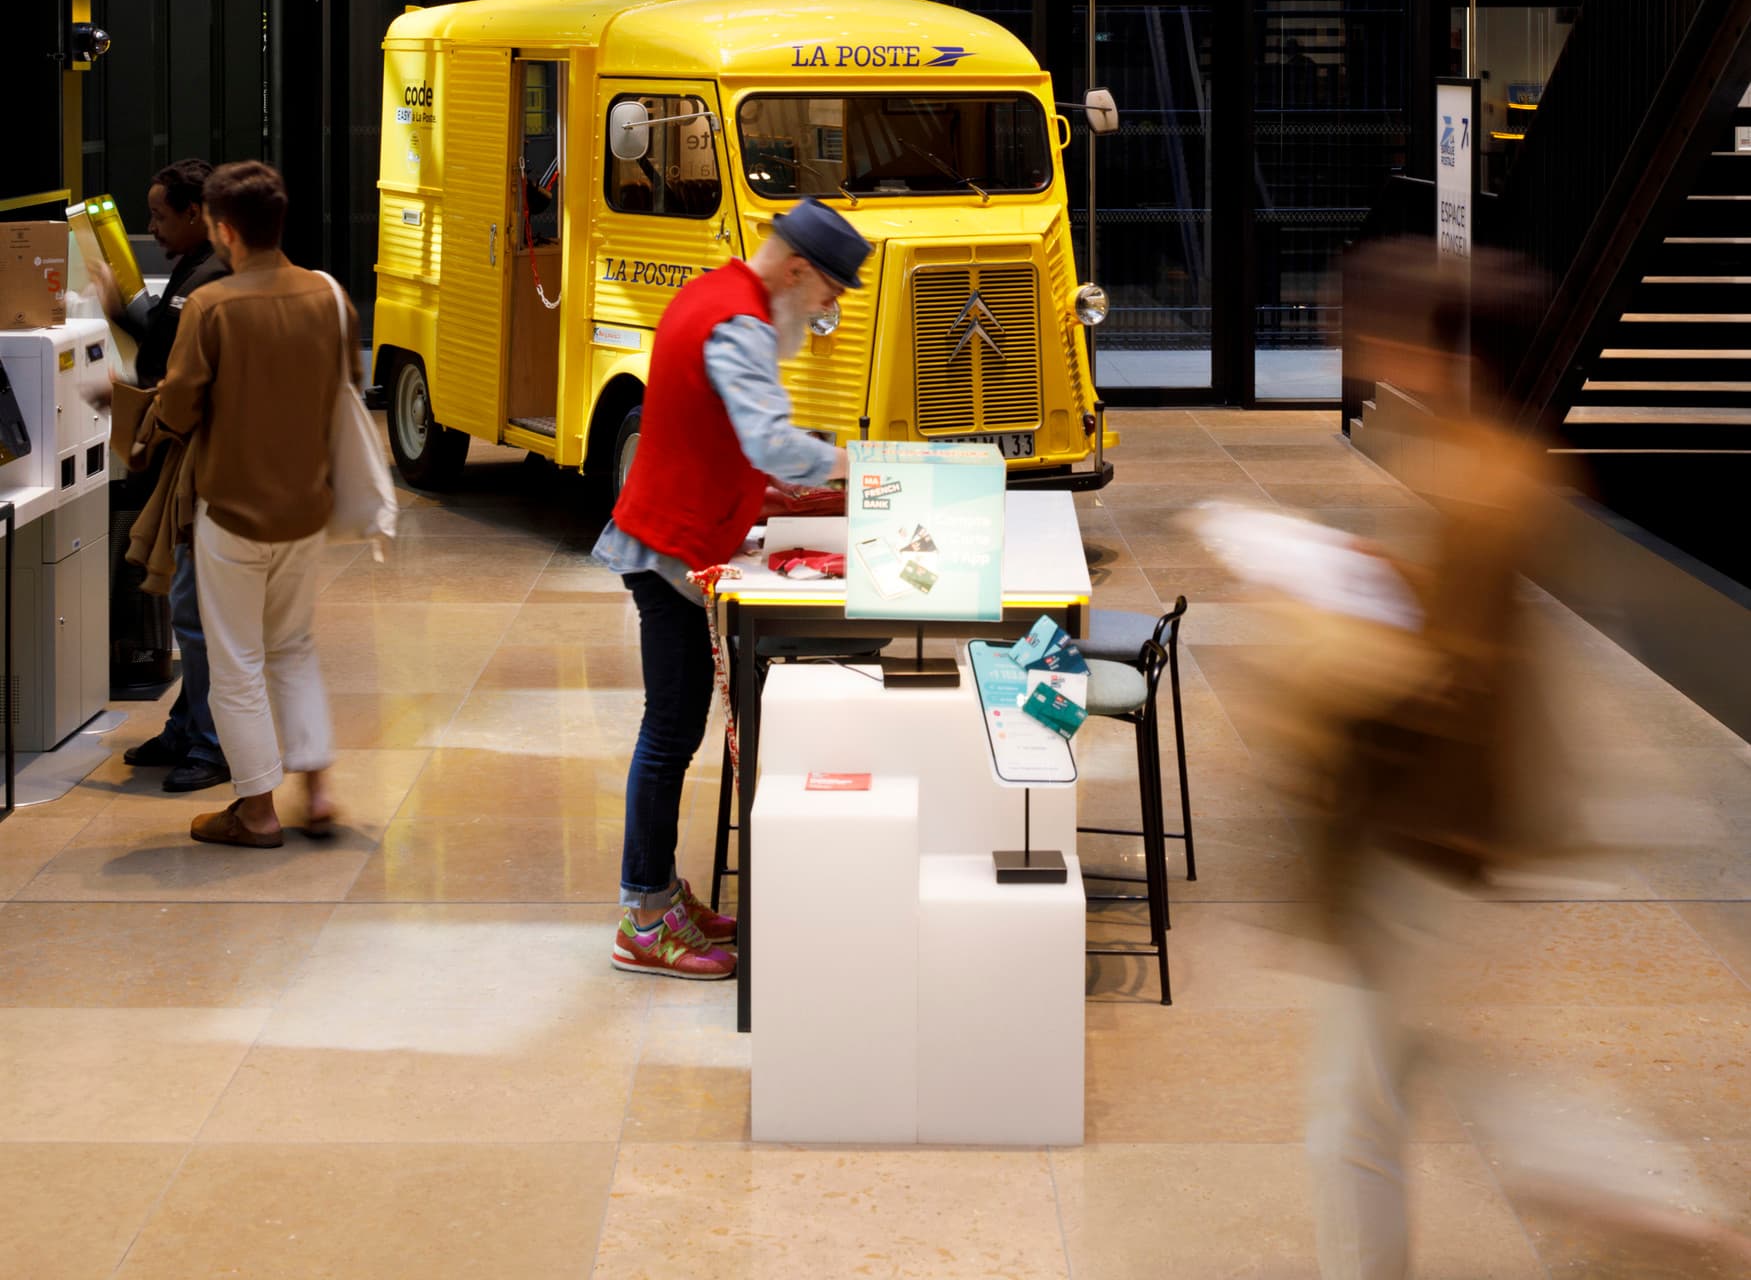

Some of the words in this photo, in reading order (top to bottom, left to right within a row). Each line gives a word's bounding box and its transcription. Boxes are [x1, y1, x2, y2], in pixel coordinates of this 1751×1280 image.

[791, 45, 828, 67] LA
[835, 45, 920, 67] POSTE
[404, 80, 434, 107] code
[1441, 201, 1465, 228] ESPACE
[602, 258, 628, 282] LA
[631, 261, 693, 288] POSTE
[1012, 434, 1033, 456] 33
[863, 483, 900, 498] FRENCH
[863, 500, 889, 509] BANK
